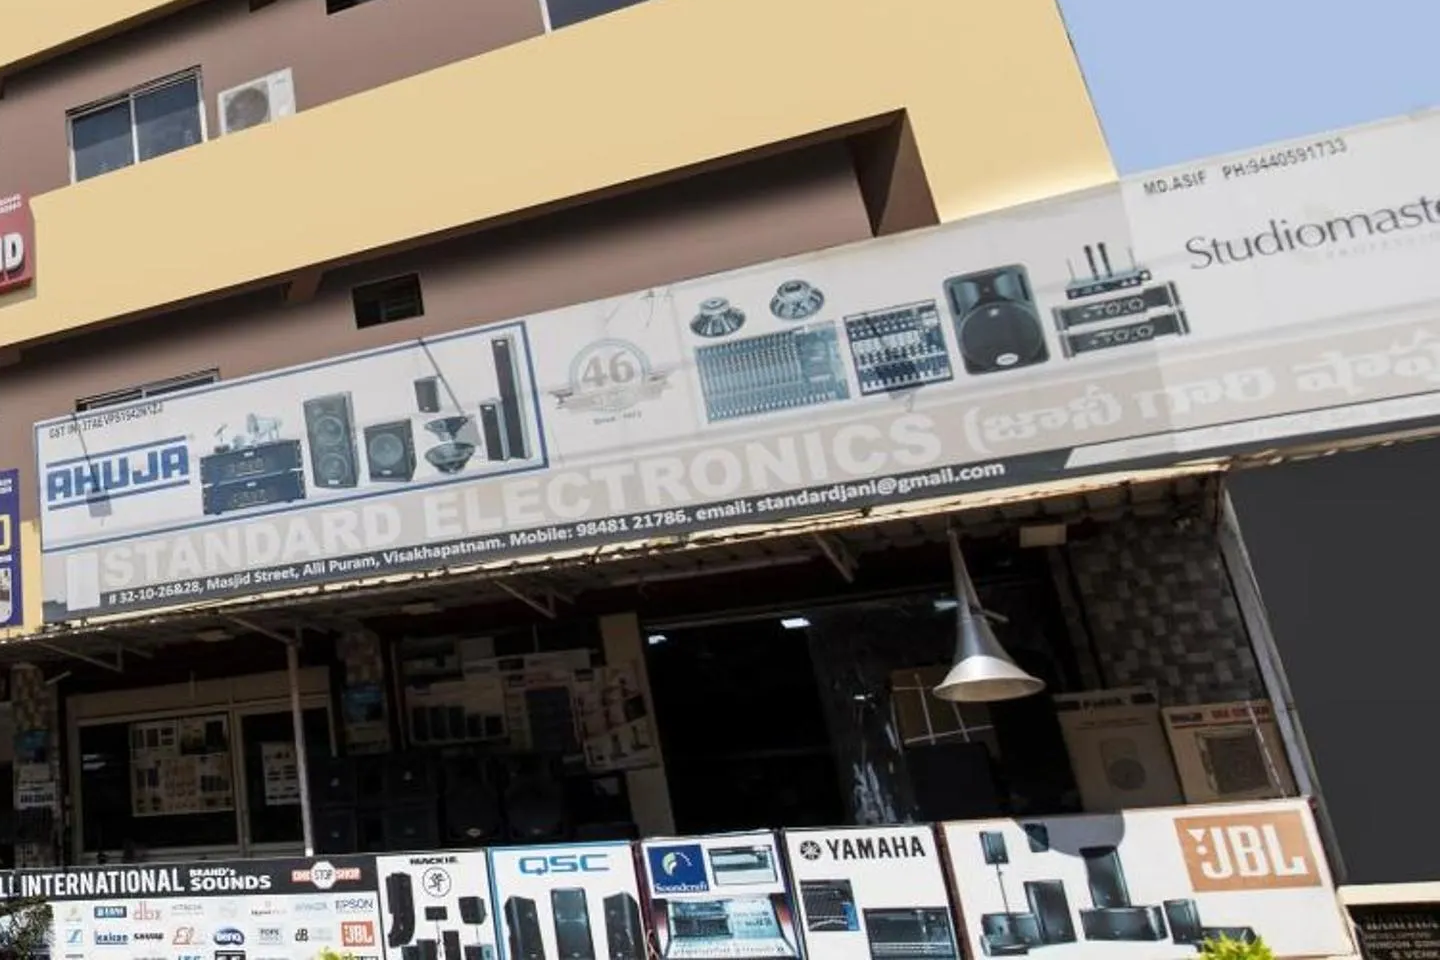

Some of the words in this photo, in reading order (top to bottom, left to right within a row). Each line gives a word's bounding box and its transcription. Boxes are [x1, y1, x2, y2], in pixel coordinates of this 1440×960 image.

[1185, 193, 1440, 270] Studiomast
[581, 349, 635, 386] 46
[48, 445, 190, 501] AHUJA
[101, 501, 402, 588] STANDARD
[424, 413, 942, 539] ELECTRONICS
[109, 594, 118, 605] #
[207, 571, 251, 593] Masjid
[255, 564, 299, 583] Street,
[329, 554, 380, 573] Puram,
[383, 536, 506, 568] Visakhapatnam.
[510, 526, 573, 547] Mobile:
[575, 519, 628, 538] 98481
[696, 500, 753, 522] email:
[756, 462, 1006, 513] standardjani@gmail.com
[826, 836, 927, 860] YAMAHA
[1201, 824, 1309, 880] JBL
[314, 868, 333, 881] STOP
[518, 853, 611, 876] QSC
[21, 868, 185, 897] INTERNATIONAL
[190, 875, 272, 891] SOUNDS
[335, 898, 374, 911] EPSON
[344, 924, 373, 944] JBL
